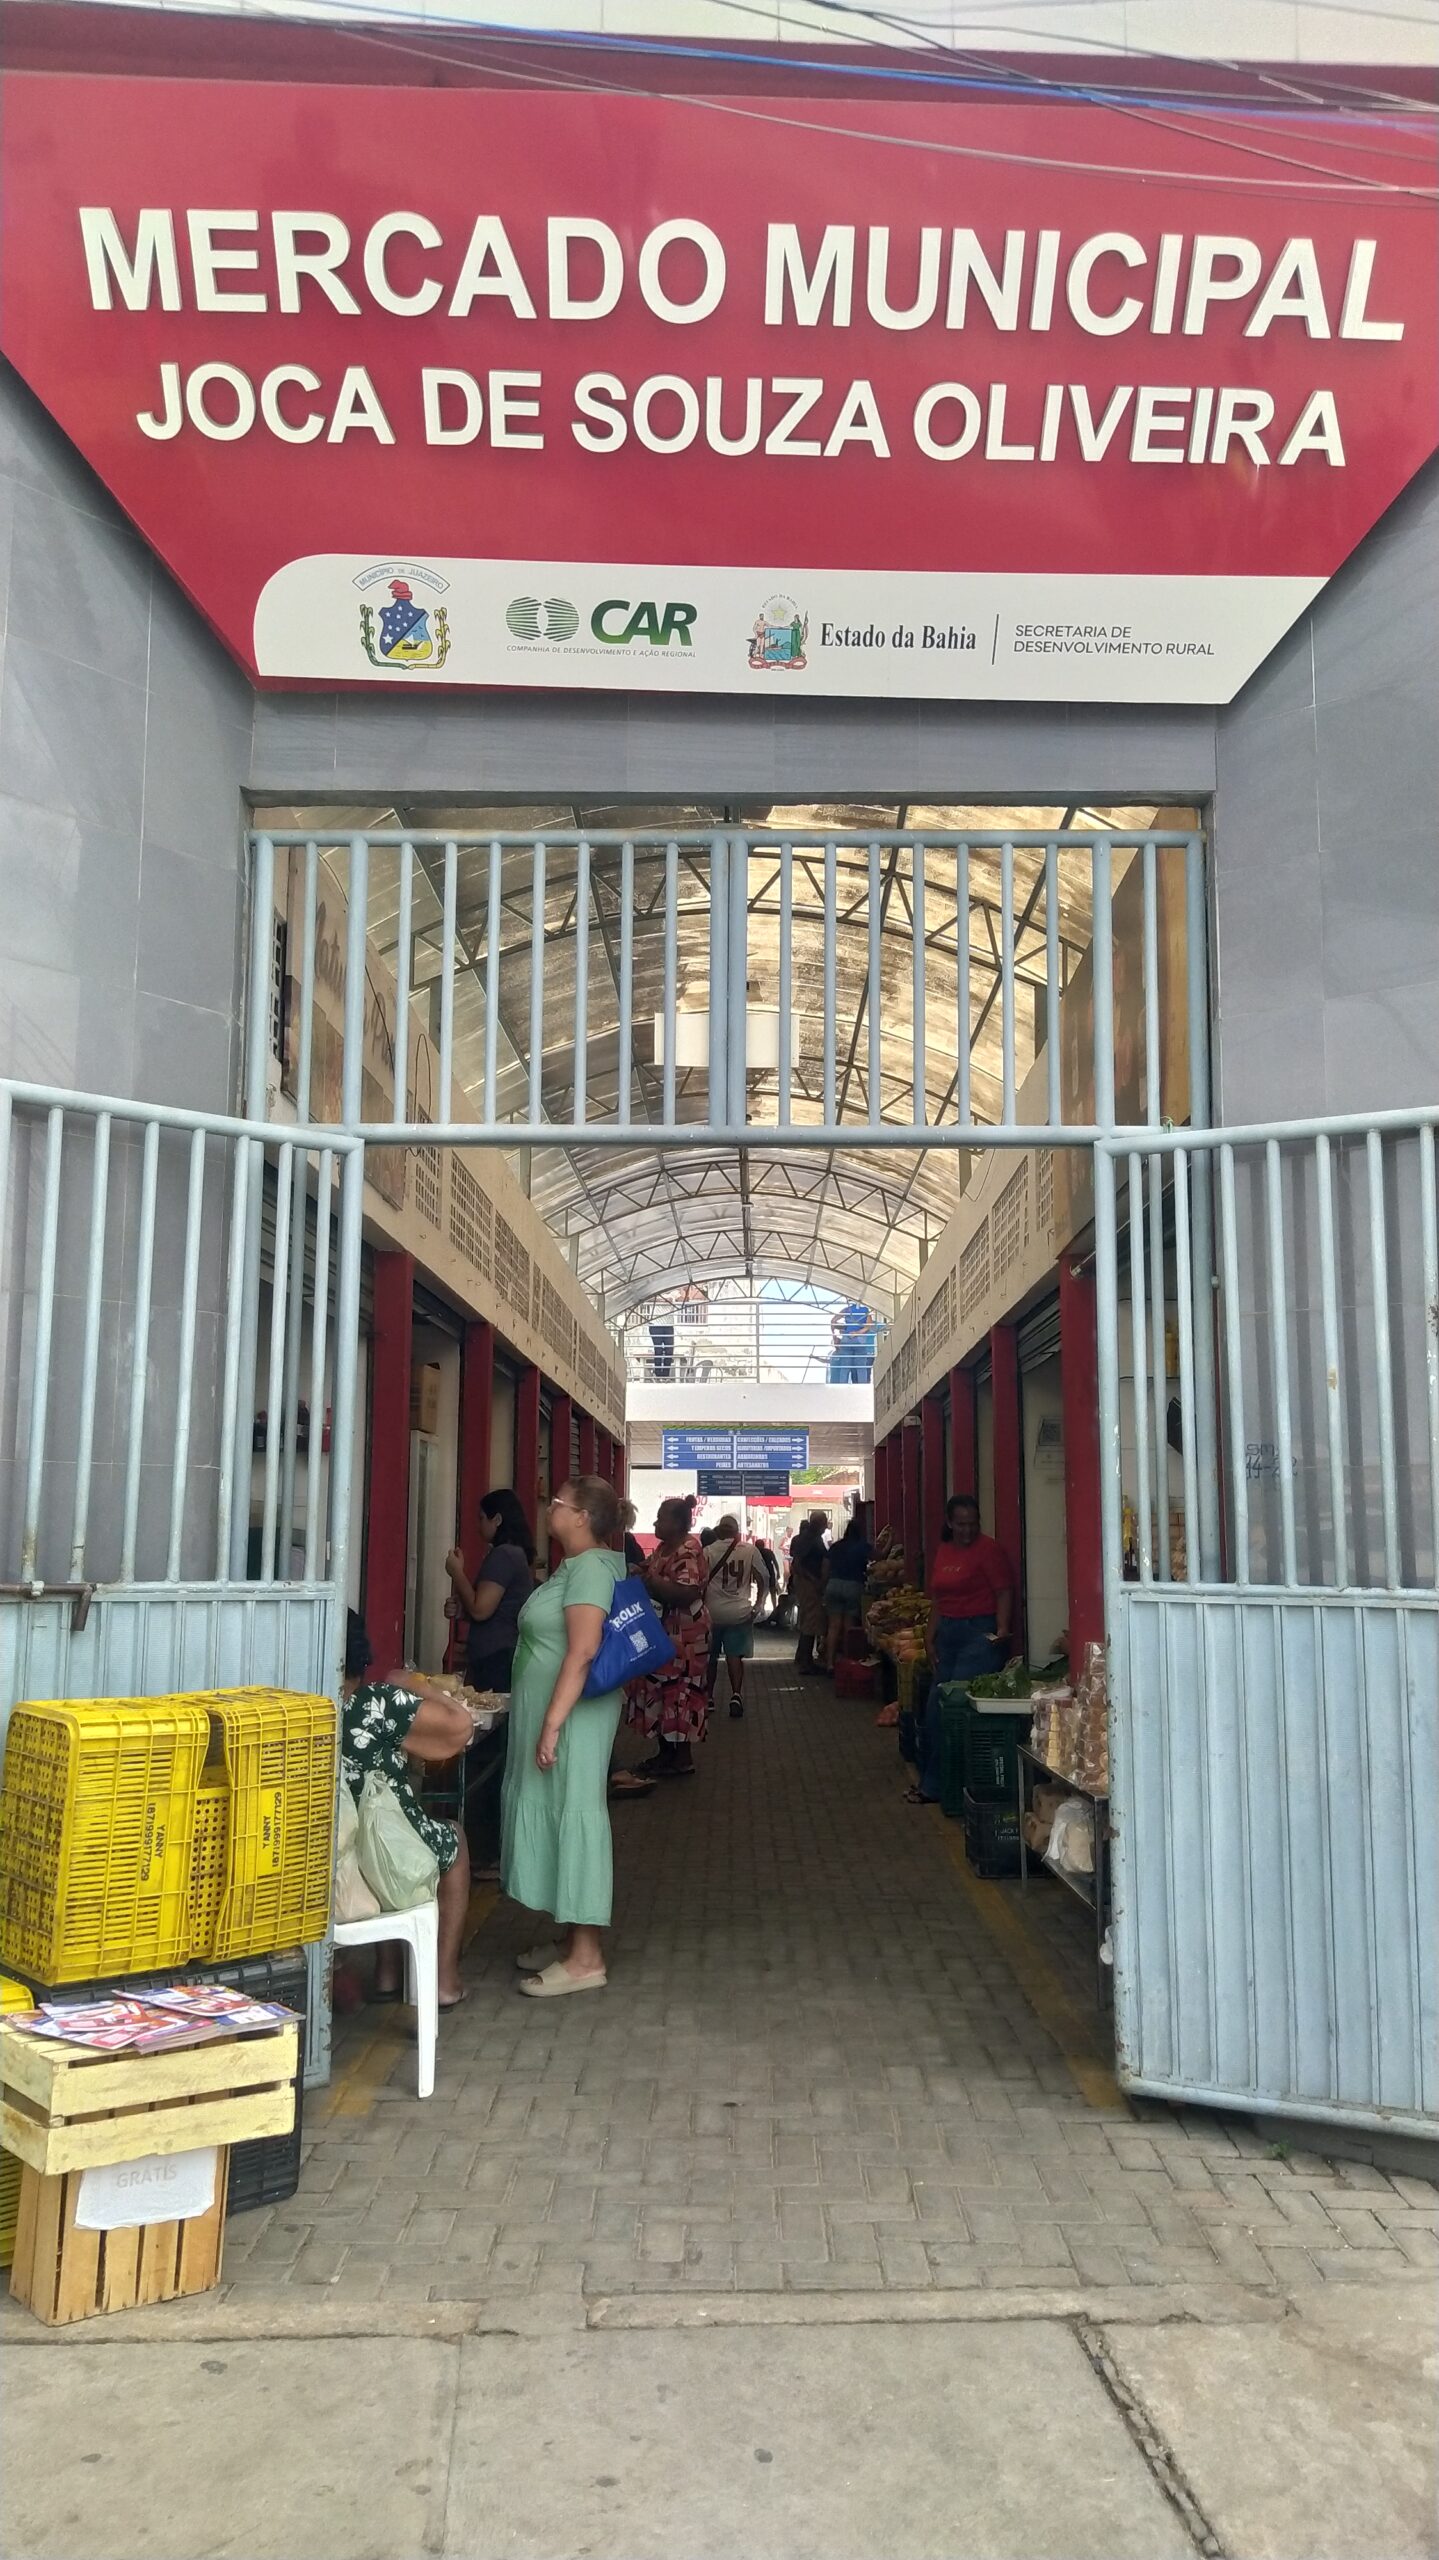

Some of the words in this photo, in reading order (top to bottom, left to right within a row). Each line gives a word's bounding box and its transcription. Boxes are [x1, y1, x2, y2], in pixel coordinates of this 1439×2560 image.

[79, 207, 725, 325] MERCADO
[764, 223, 1405, 343] MUNICIPAL
[136, 362, 394, 445] JOCA
[421, 368, 543, 451] DE
[571, 373, 891, 460] SOUZA
[913, 382, 1346, 470] OLIVEIRA
[409, 568, 444, 590] JUAZEIRO
[591, 599, 698, 647] CAR
[821, 622, 886, 649] Estado
[892, 624, 914, 650] da
[921, 625, 976, 651] Bahia
[1015, 624, 1108, 638] SECRETARIA
[1110, 626, 1132, 639] DE
[506, 644, 550, 653] COMPANHIA
[552, 646, 561, 654] DE
[563, 646, 631, 656] DESENVOLVIMENTO
[638, 648, 660, 658] AÇÃO
[661, 650, 696, 658] REGIONAL
[1014, 640, 1163, 656] DESENVOLVIMENTO
[1165, 642, 1215, 657] RURAL
[154, 1824, 166, 1858] YANNY
[262, 1815, 271, 1849] YANNY
